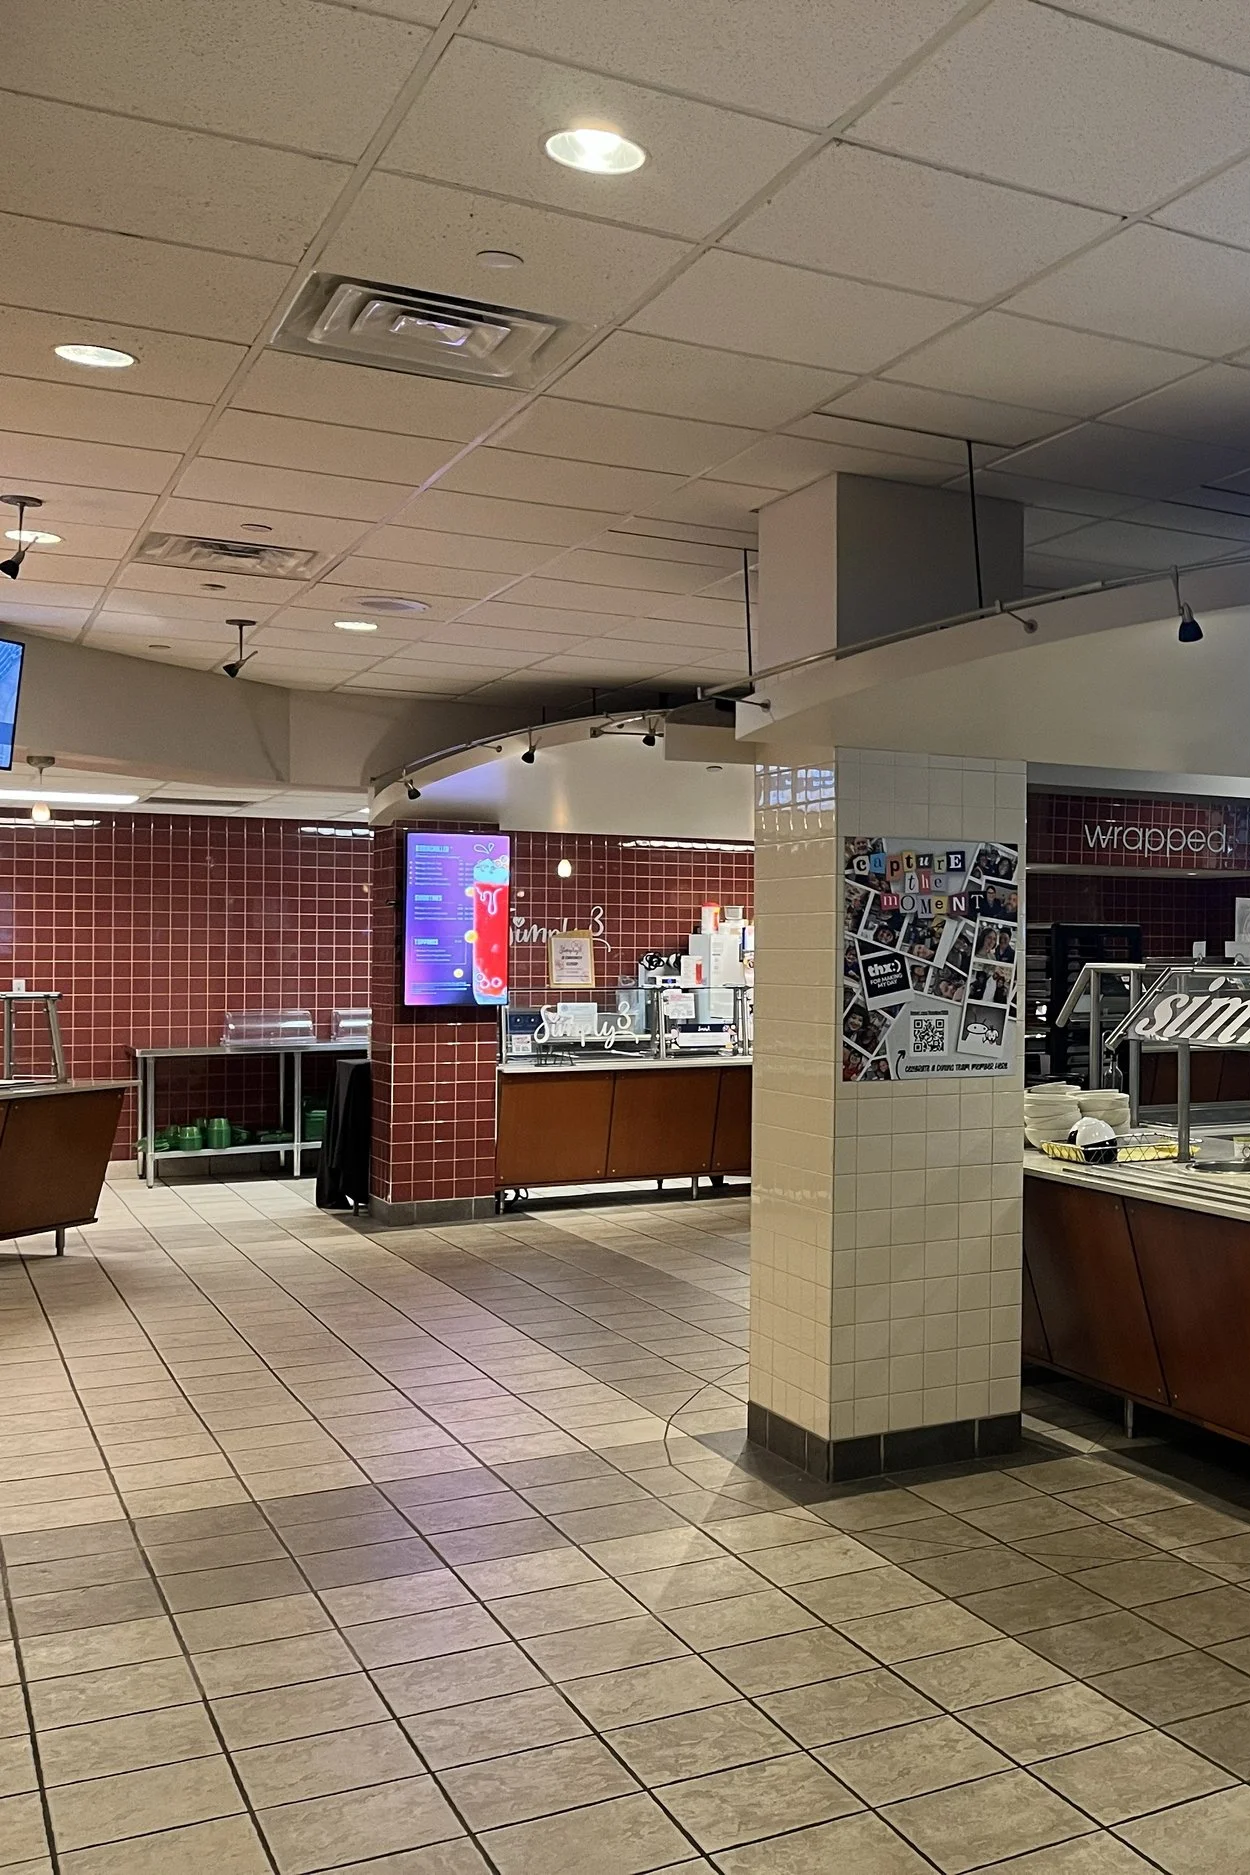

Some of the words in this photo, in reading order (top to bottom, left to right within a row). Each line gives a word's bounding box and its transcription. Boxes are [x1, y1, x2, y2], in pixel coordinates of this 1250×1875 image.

[1084, 824, 1226, 858] wrapped
[909, 874, 942, 890] the
[533, 1004, 617, 1049] Simply
